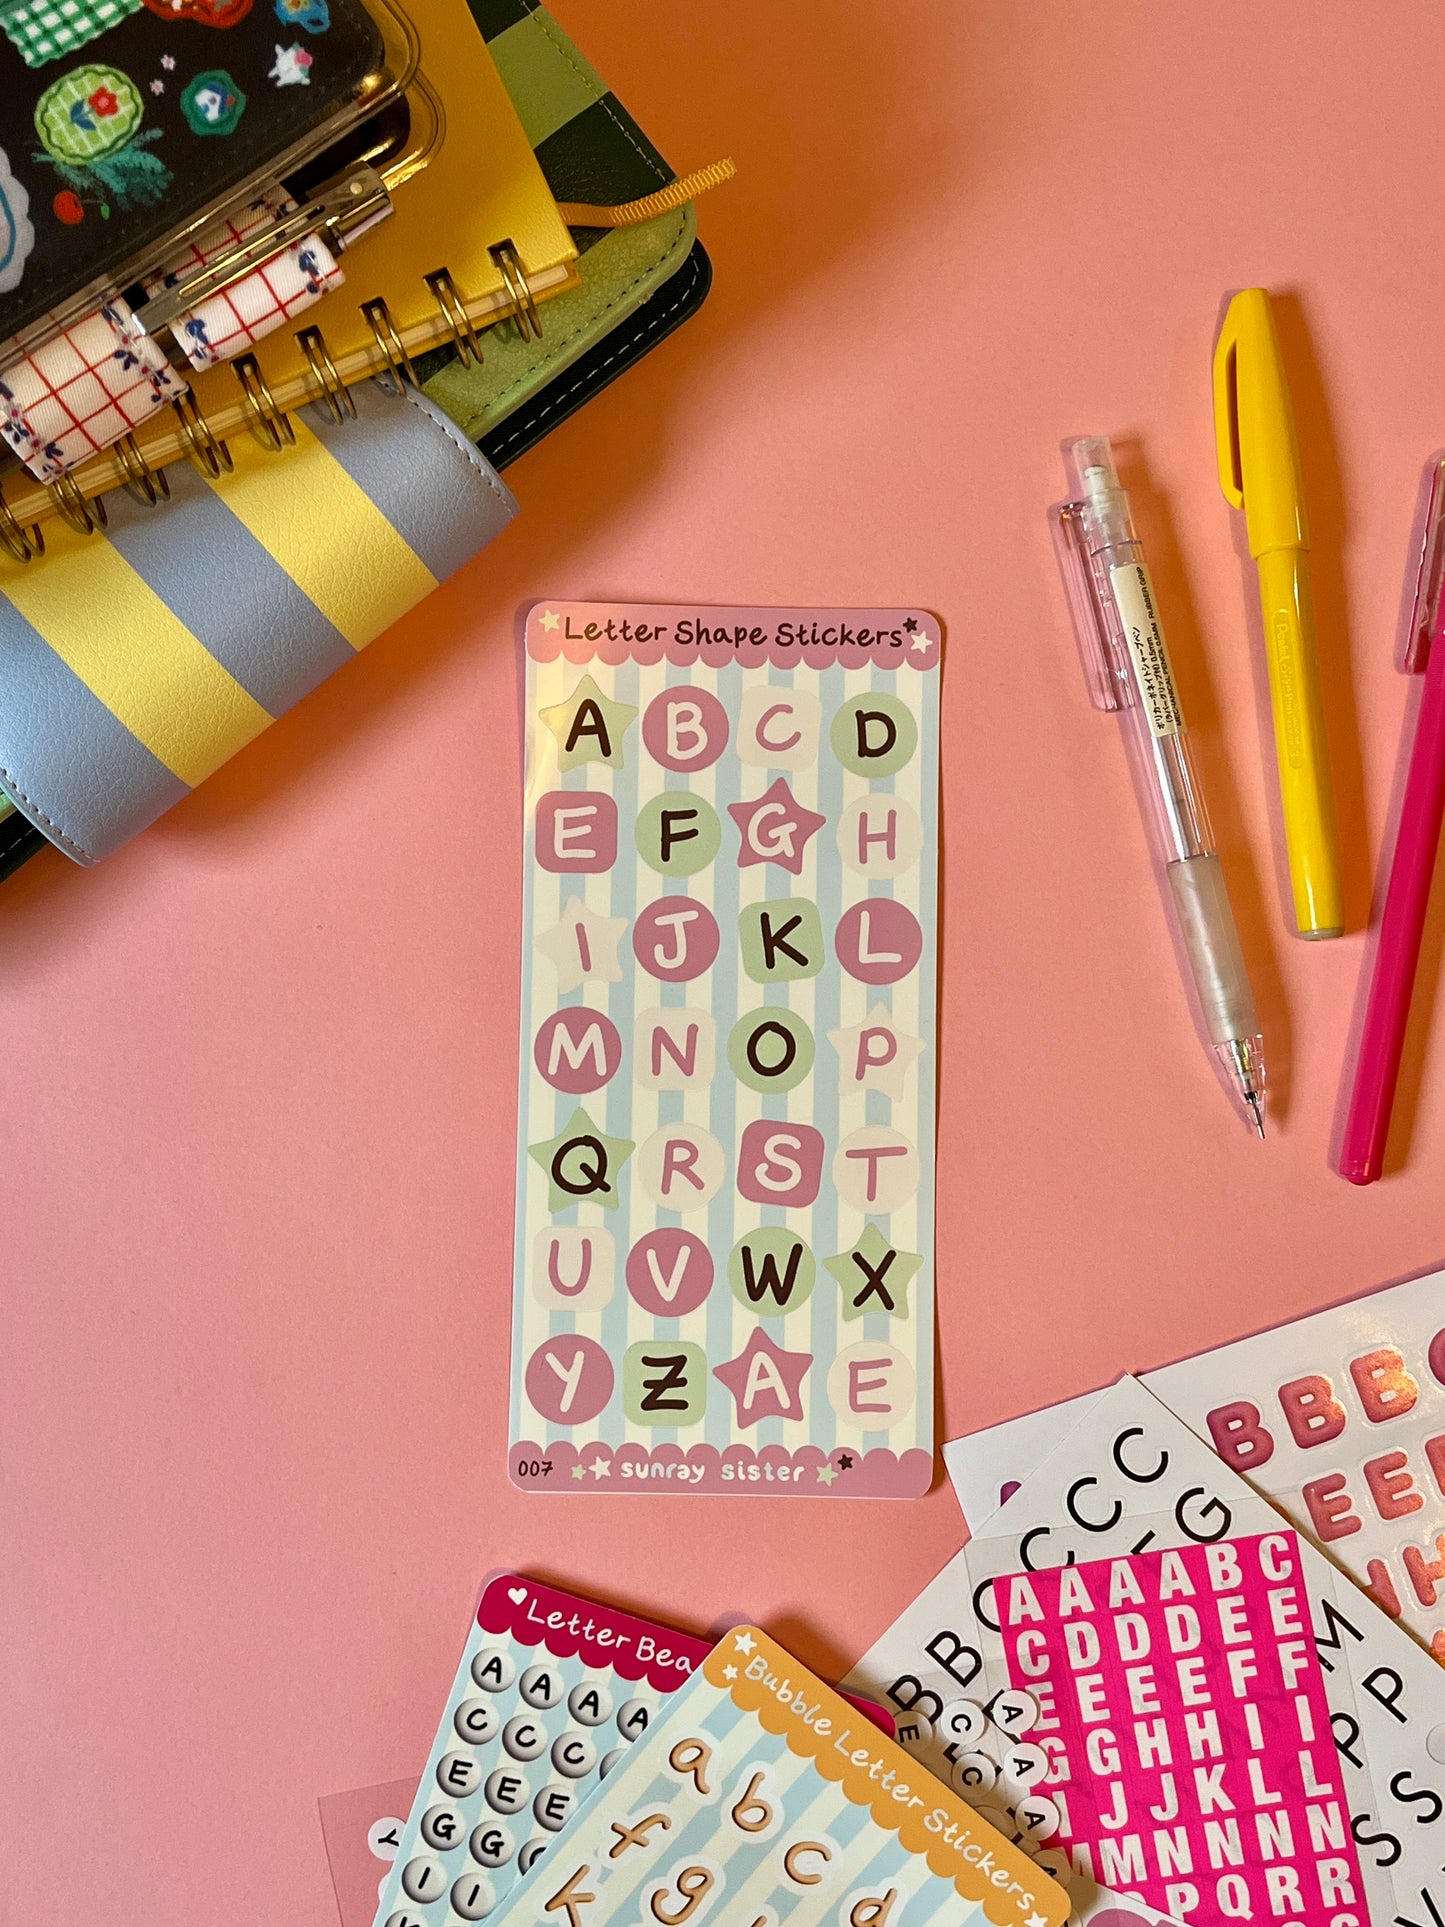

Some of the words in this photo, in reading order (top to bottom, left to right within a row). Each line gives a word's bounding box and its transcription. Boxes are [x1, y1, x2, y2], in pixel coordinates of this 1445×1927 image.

[1136, 566, 1146, 586] GRIP
[1141, 586, 1155, 619] RUBBER
[564, 616, 667, 641] Letter
[674, 619, 767, 648] Shape
[775, 622, 902, 648] Stickers
[1147, 636, 1158, 662] 0.5mm
[1158, 647, 1169, 675] PENCIL
[565, 698, 612, 758] A
[666, 701, 709, 760] B
[755, 703, 801, 752] C
[855, 710, 897, 758] D
[1165, 675, 1181, 726] MECHANICAL
[554, 805, 598, 859] E
[660, 809, 699, 863] F
[748, 802, 798, 858] G
[859, 809, 898, 865] H
[575, 922, 591, 972] I
[654, 910, 699, 969] J
[760, 912, 809, 969] K
[859, 910, 902, 963] L
[548, 1022, 607, 1077] M
[651, 1023, 699, 1077] N
[746, 1021, 797, 1077] O
[855, 1026, 898, 1081] P
[551, 1134, 612, 1195] Q
[660, 1139, 705, 1195] R
[754, 1133, 802, 1192] S
[845, 1146, 908, 1201] T
[548, 1238, 592, 1297] U
[646, 1245, 691, 1302] V
[741, 1243, 803, 1306] W
[851, 1250, 897, 1310] X
[545, 1350, 585, 1413] Y
[640, 1354, 689, 1411] Z
[742, 1351, 791, 1410] A
[849, 1358, 893, 1413] E
[1206, 1400, 1275, 1474] B
[1277, 1374, 1347, 1449] B
[1349, 1349, 1419, 1423] B
[517, 1460, 554, 1477] 007
[620, 1461, 705, 1485] sunray
[720, 1459, 805, 1483] sister
[1302, 1472, 1363, 1543] E
[1363, 1451, 1424, 1521] E
[1175, 1487, 1231, 1543] G
[924, 1630, 982, 1688] B
[1067, 1476, 1122, 1533] C
[1112, 1427, 1169, 1483] C
[1008, 1575, 1044, 1625] A
[1058, 1567, 1095, 1616] A
[1108, 1559, 1145, 1609] A
[1158, 1551, 1195, 1601] A
[1204, 1543, 1244, 1592] B
[1258, 1534, 1293, 1582] C
[528, 1599, 630, 1648] Letter
[1015, 1629, 1052, 1677] C
[1064, 1620, 1100, 1669] D
[1114, 1612, 1151, 1662] D
[1163, 1604, 1201, 1654] D
[1216, 1595, 1254, 1645] E
[1267, 1587, 1304, 1636] E
[481, 1656, 502, 1684] A
[530, 1674, 551, 1701] A
[577, 1690, 599, 1718] A
[626, 1707, 649, 1732] A
[1075, 1674, 1111, 1724] E
[1125, 1665, 1162, 1715] E
[1176, 1656, 1212, 1706] E
[1226, 1648, 1259, 1698] F
[1278, 1640, 1309, 1690] F
[465, 1708, 488, 1731] C
[514, 1725, 537, 1748] C
[562, 1742, 586, 1765] C
[899, 1724, 920, 1743] E
[951, 1713, 972, 1733] C
[1085, 1728, 1122, 1777] G
[1133, 1718, 1174, 1769] H
[1183, 1709, 1223, 1761] H
[1244, 1703, 1265, 1751] I
[1295, 1695, 1315, 1743] I
[1329, 1712, 1364, 1769] P
[1361, 1667, 1408, 1724] P
[448, 1759, 473, 1787] E
[497, 1776, 522, 1804] E
[545, 1793, 570, 1820] E
[744, 1655, 832, 1737] Bubble
[833, 1729, 926, 1809] Letter
[923, 1808, 1035, 1911] Stickers
[961, 1766, 983, 1786] C
[1002, 1705, 1024, 1724] A
[1013, 1757, 1035, 1777] A
[1024, 1811, 1047, 1830] A
[1099, 1780, 1129, 1830] J
[1150, 1772, 1181, 1822] J
[1192, 1763, 1236, 1815] K
[1247, 1758, 1282, 1807] L
[1298, 1750, 1333, 1798] L
[432, 1813, 457, 1841] G
[481, 1830, 505, 1858] G
[669, 1737, 711, 1795] a
[732, 1771, 773, 1832] b
[784, 1840, 832, 1886] c
[850, 1887, 898, 1927] d
[1098, 1833, 1148, 1887] M
[1153, 1825, 1194, 1878] N
[1203, 1817, 1244, 1869] N
[1255, 1809, 1296, 1861] N
[1306, 1801, 1347, 1853] N
[1350, 1813, 1402, 1867] S
[1390, 1771, 1443, 1824] S
[417, 1866, 431, 1890] I
[467, 1884, 480, 1907] I
[609, 1813, 672, 1858] f
[650, 1866, 715, 1925] g
[1164, 1883, 1200, 1920] P
[1216, 1874, 1255, 1922] Q
[1266, 1866, 1307, 1915] R
[1316, 1858, 1357, 1907] R
